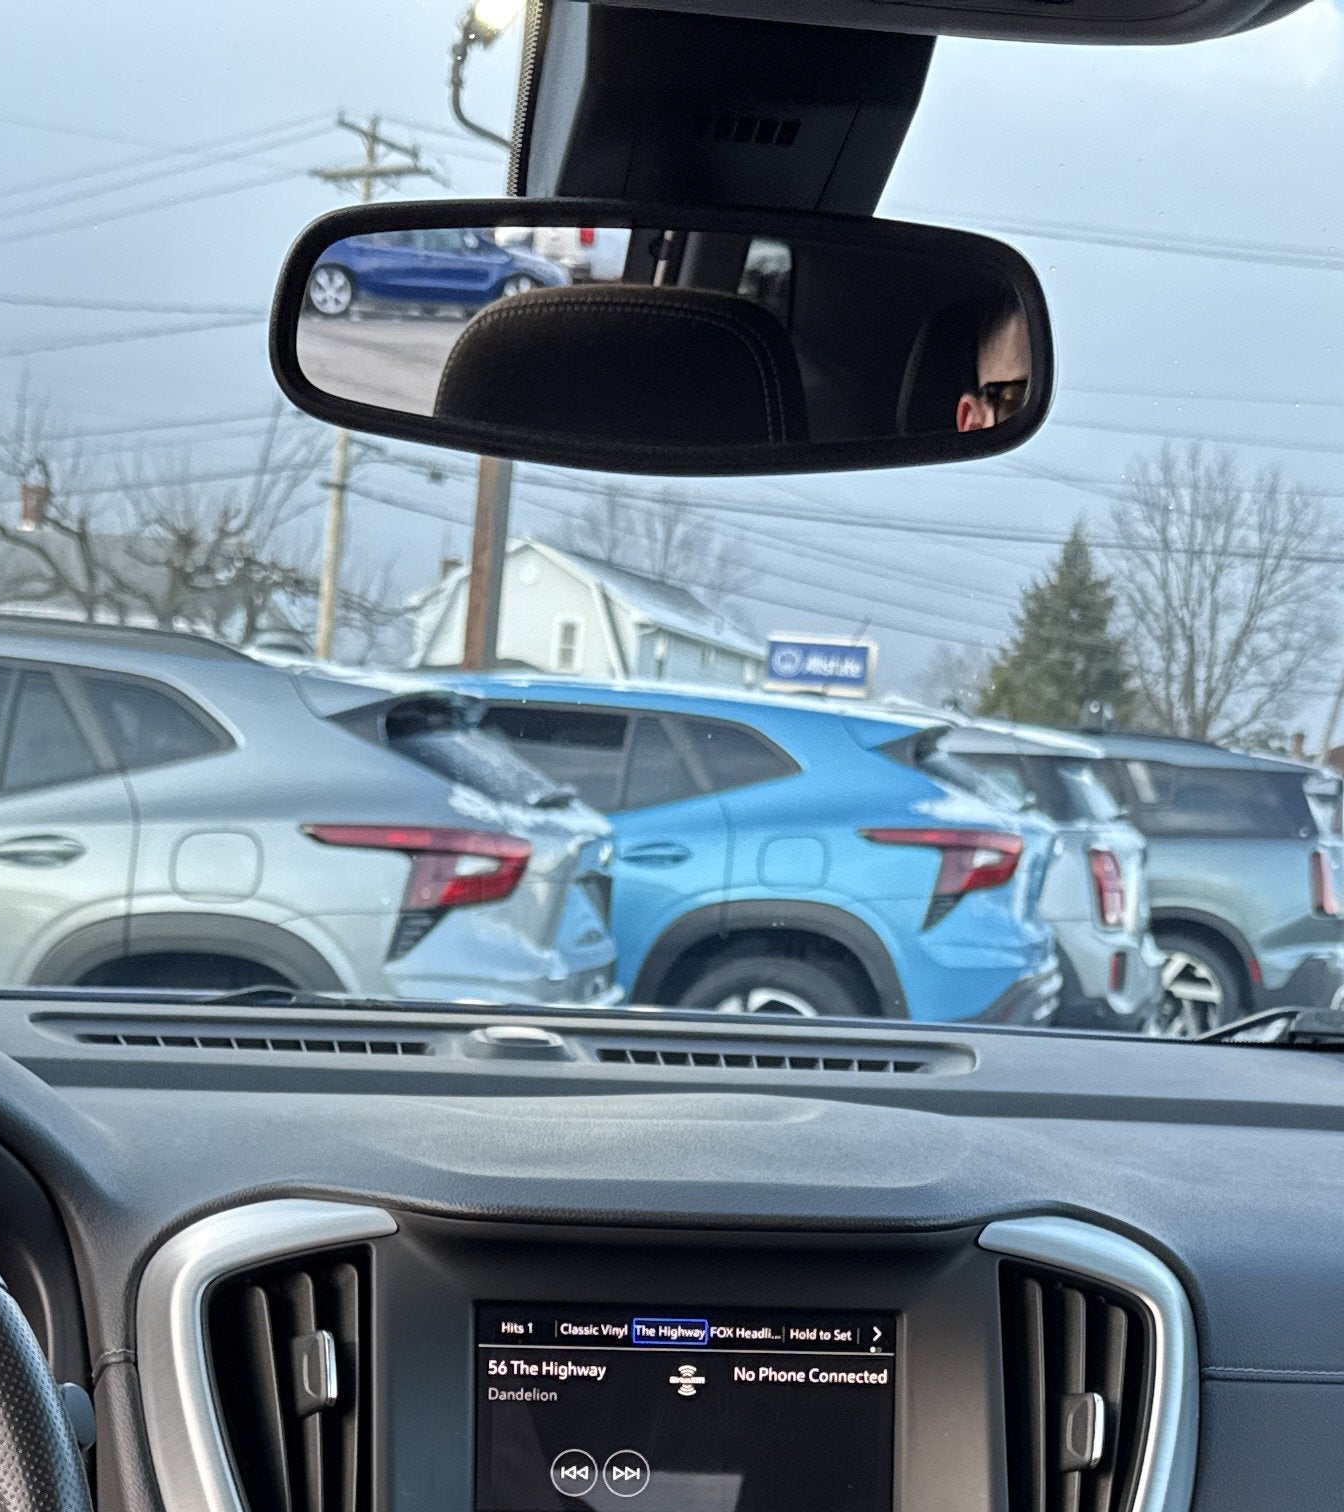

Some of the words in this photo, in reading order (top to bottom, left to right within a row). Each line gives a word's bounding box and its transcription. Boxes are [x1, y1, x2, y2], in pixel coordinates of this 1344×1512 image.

[501, 1321, 525, 1335] Hits
[527, 1322, 534, 1334] 1
[560, 1322, 599, 1336] Classic
[600, 1323, 628, 1339] Vinyl
[634, 1324, 656, 1337] The
[658, 1325, 707, 1340] Highway
[710, 1326, 734, 1339] FOX
[790, 1328, 817, 1341] Hold
[819, 1330, 832, 1341] to
[833, 1329, 852, 1342] Set
[488, 1360, 507, 1376] 56
[510, 1360, 539, 1377] The
[542, 1361, 606, 1381] Highway
[733, 1366, 756, 1383] No
[758, 1366, 806, 1384] Phone
[808, 1368, 888, 1385] Connected
[488, 1387, 558, 1402] Dandelion
